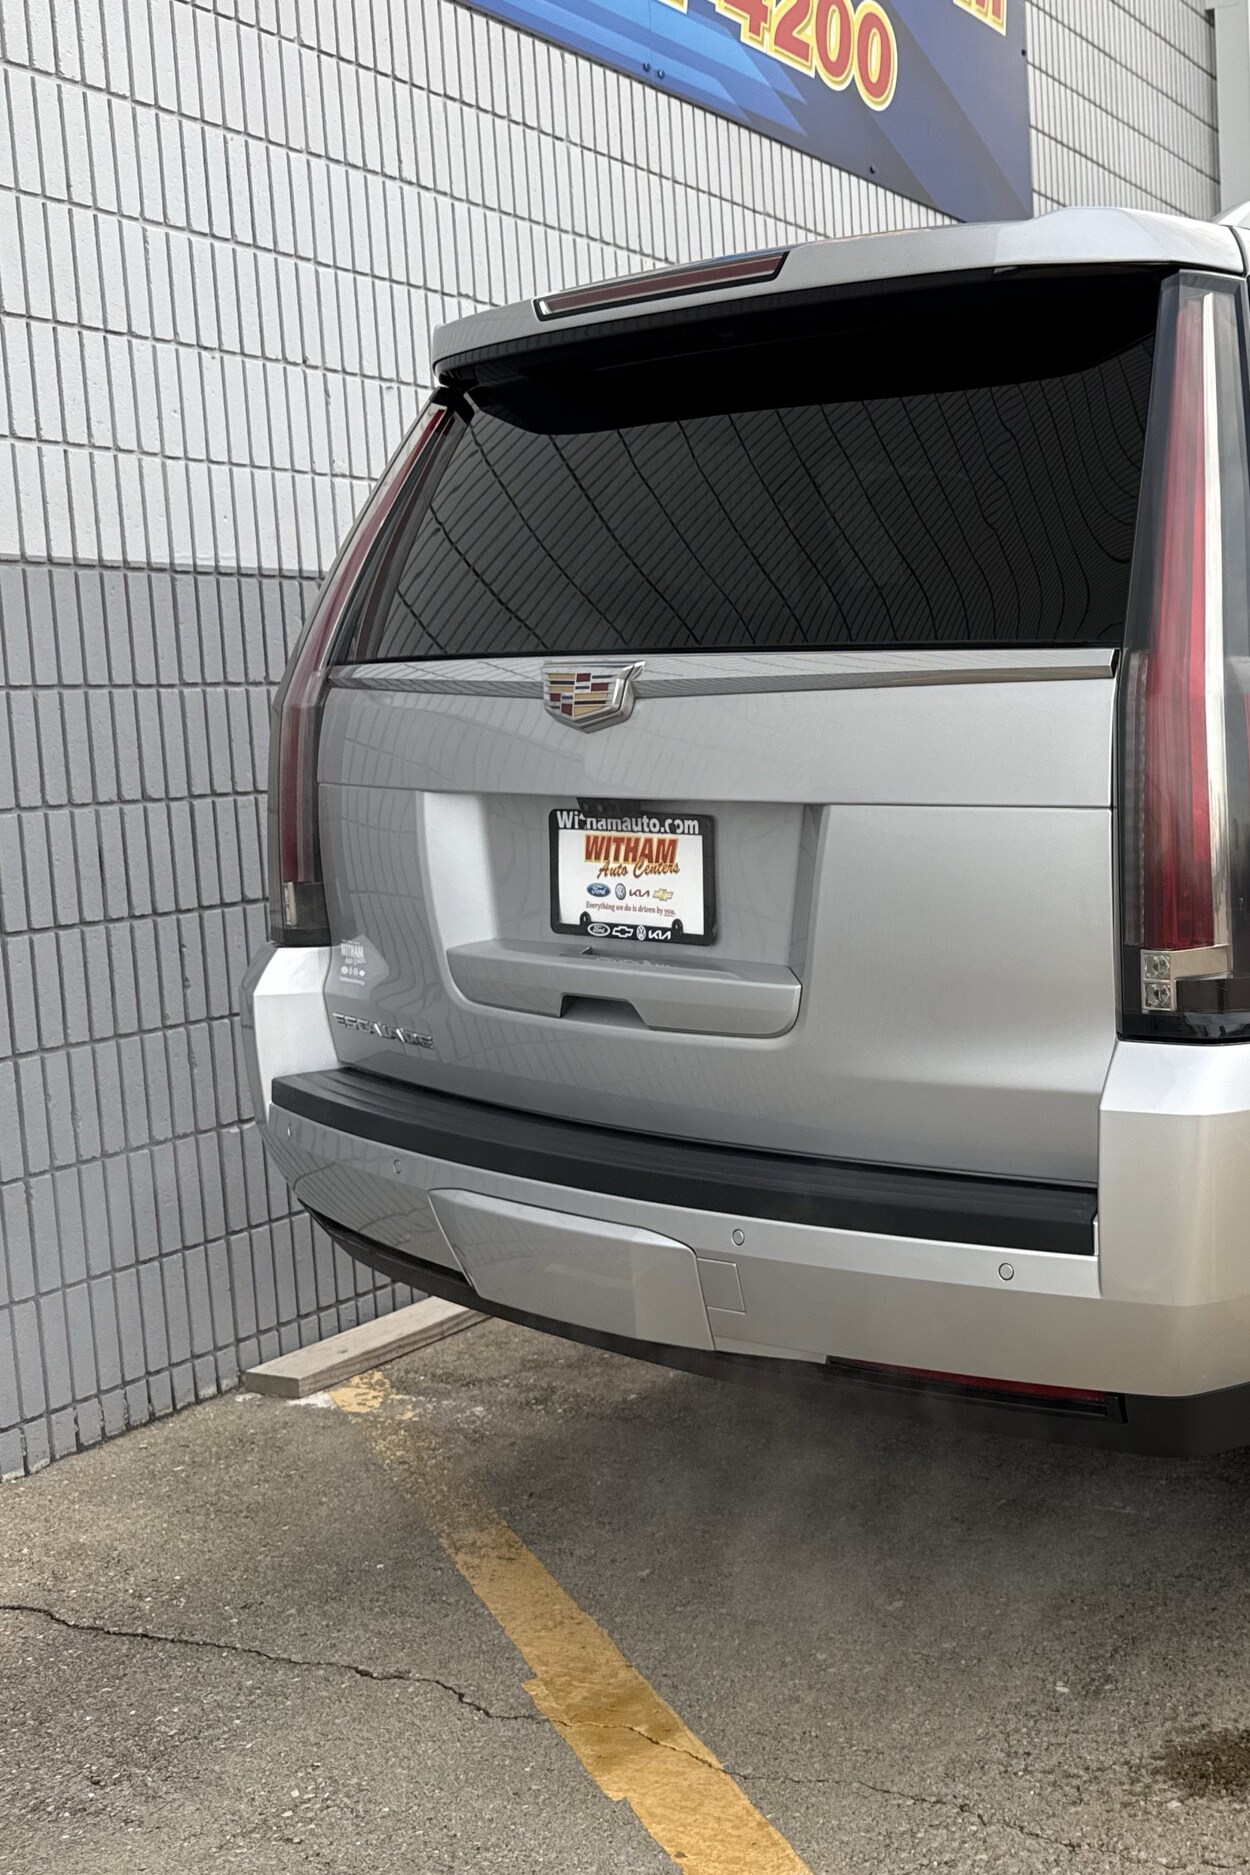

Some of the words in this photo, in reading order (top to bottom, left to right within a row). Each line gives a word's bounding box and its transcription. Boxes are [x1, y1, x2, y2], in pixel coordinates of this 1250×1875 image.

[585, 834, 679, 864] WITHAM
[597, 860, 628, 879] Auto
[633, 858, 680, 879] Centers
[586, 901, 615, 912] Everything
[625, 904, 632, 912] do
[638, 905, 656, 914] driven
[656, 905, 664, 916] by
